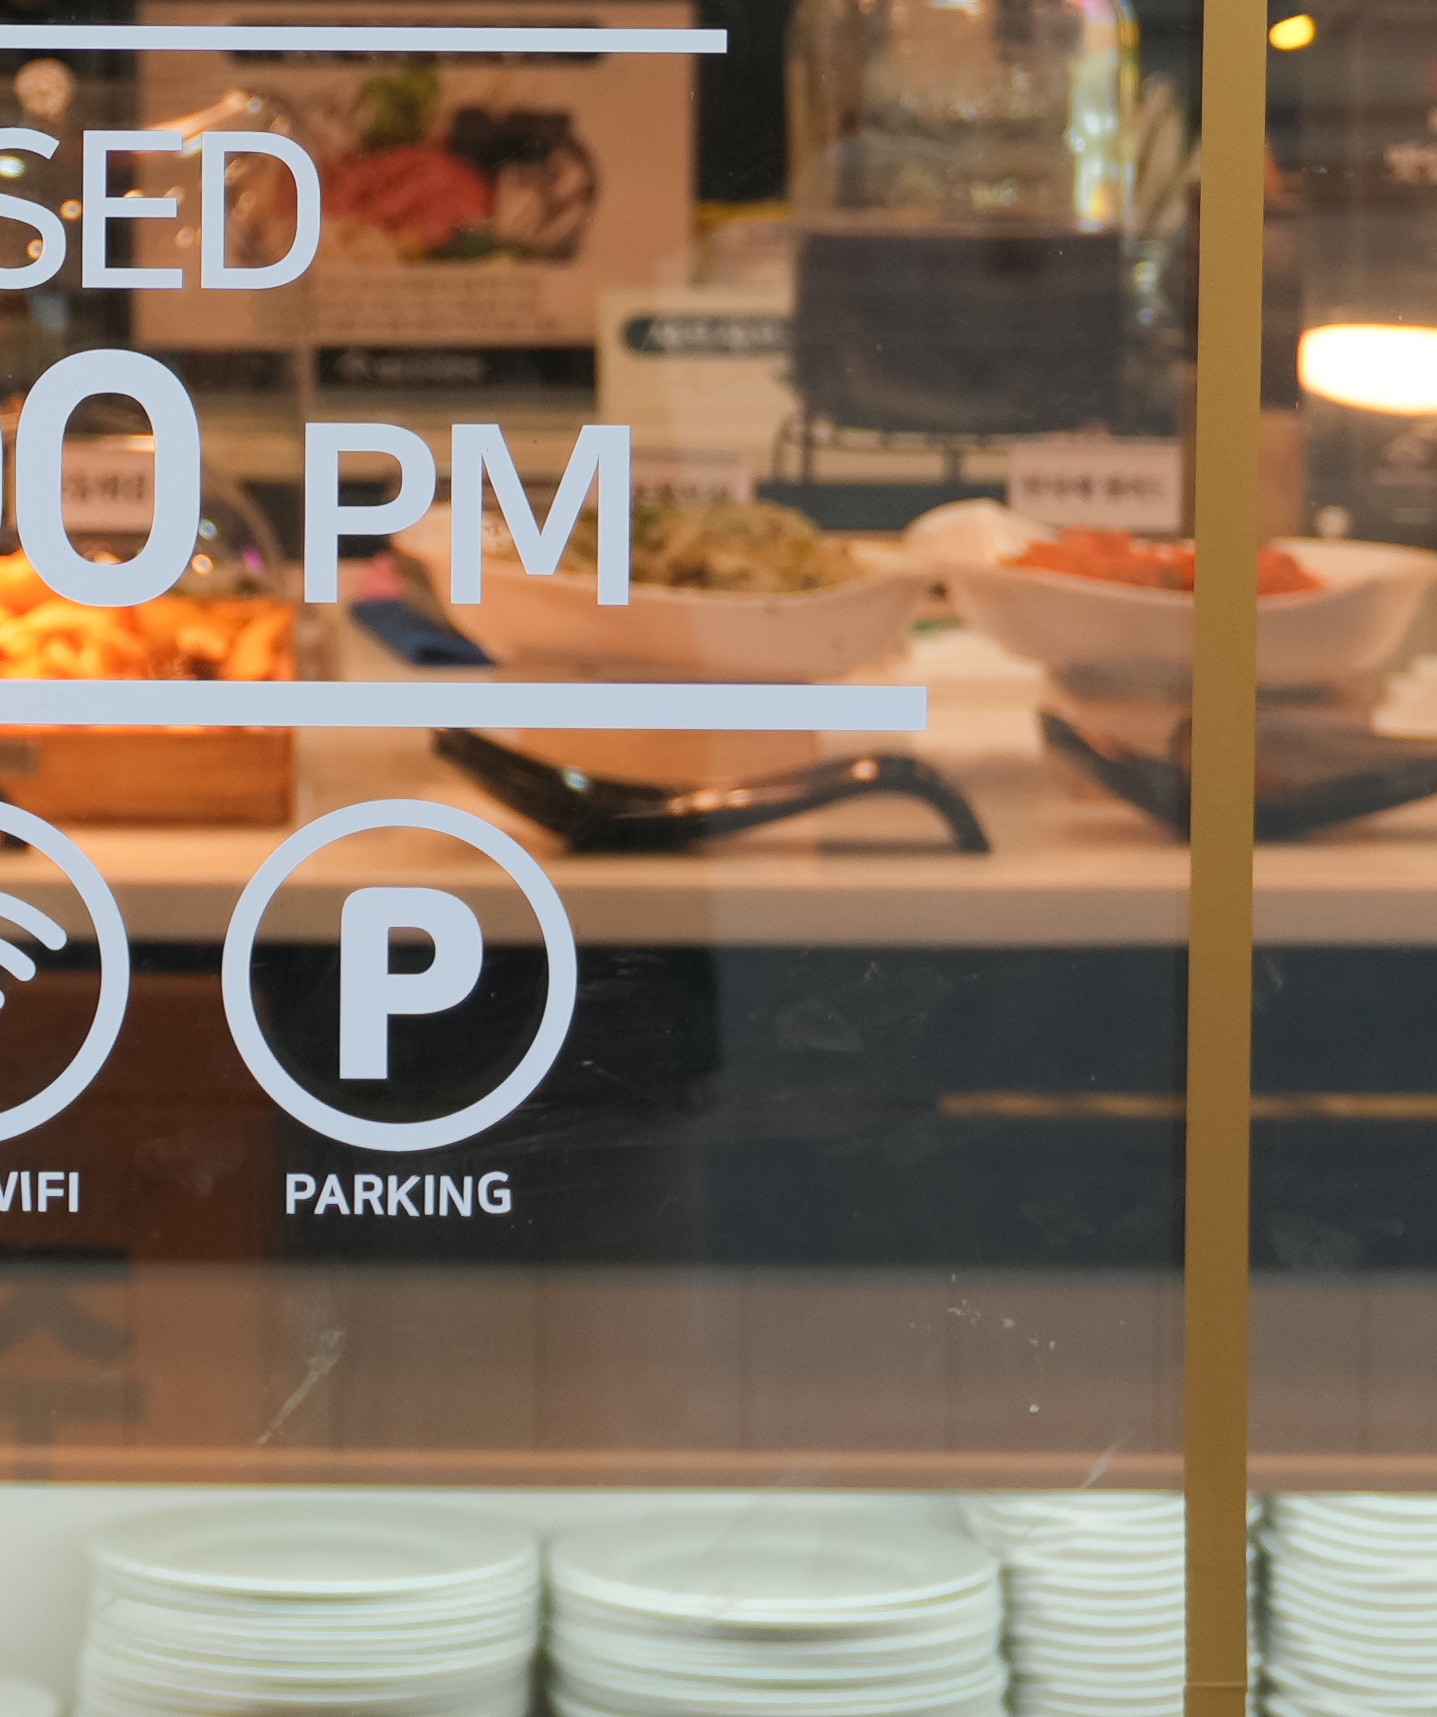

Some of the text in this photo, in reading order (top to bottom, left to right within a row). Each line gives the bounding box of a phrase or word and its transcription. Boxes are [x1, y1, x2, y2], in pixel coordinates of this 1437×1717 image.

[303, 422, 632, 607] PM
[339, 886, 484, 1080] P
[285, 1170, 513, 1218] PARKING
